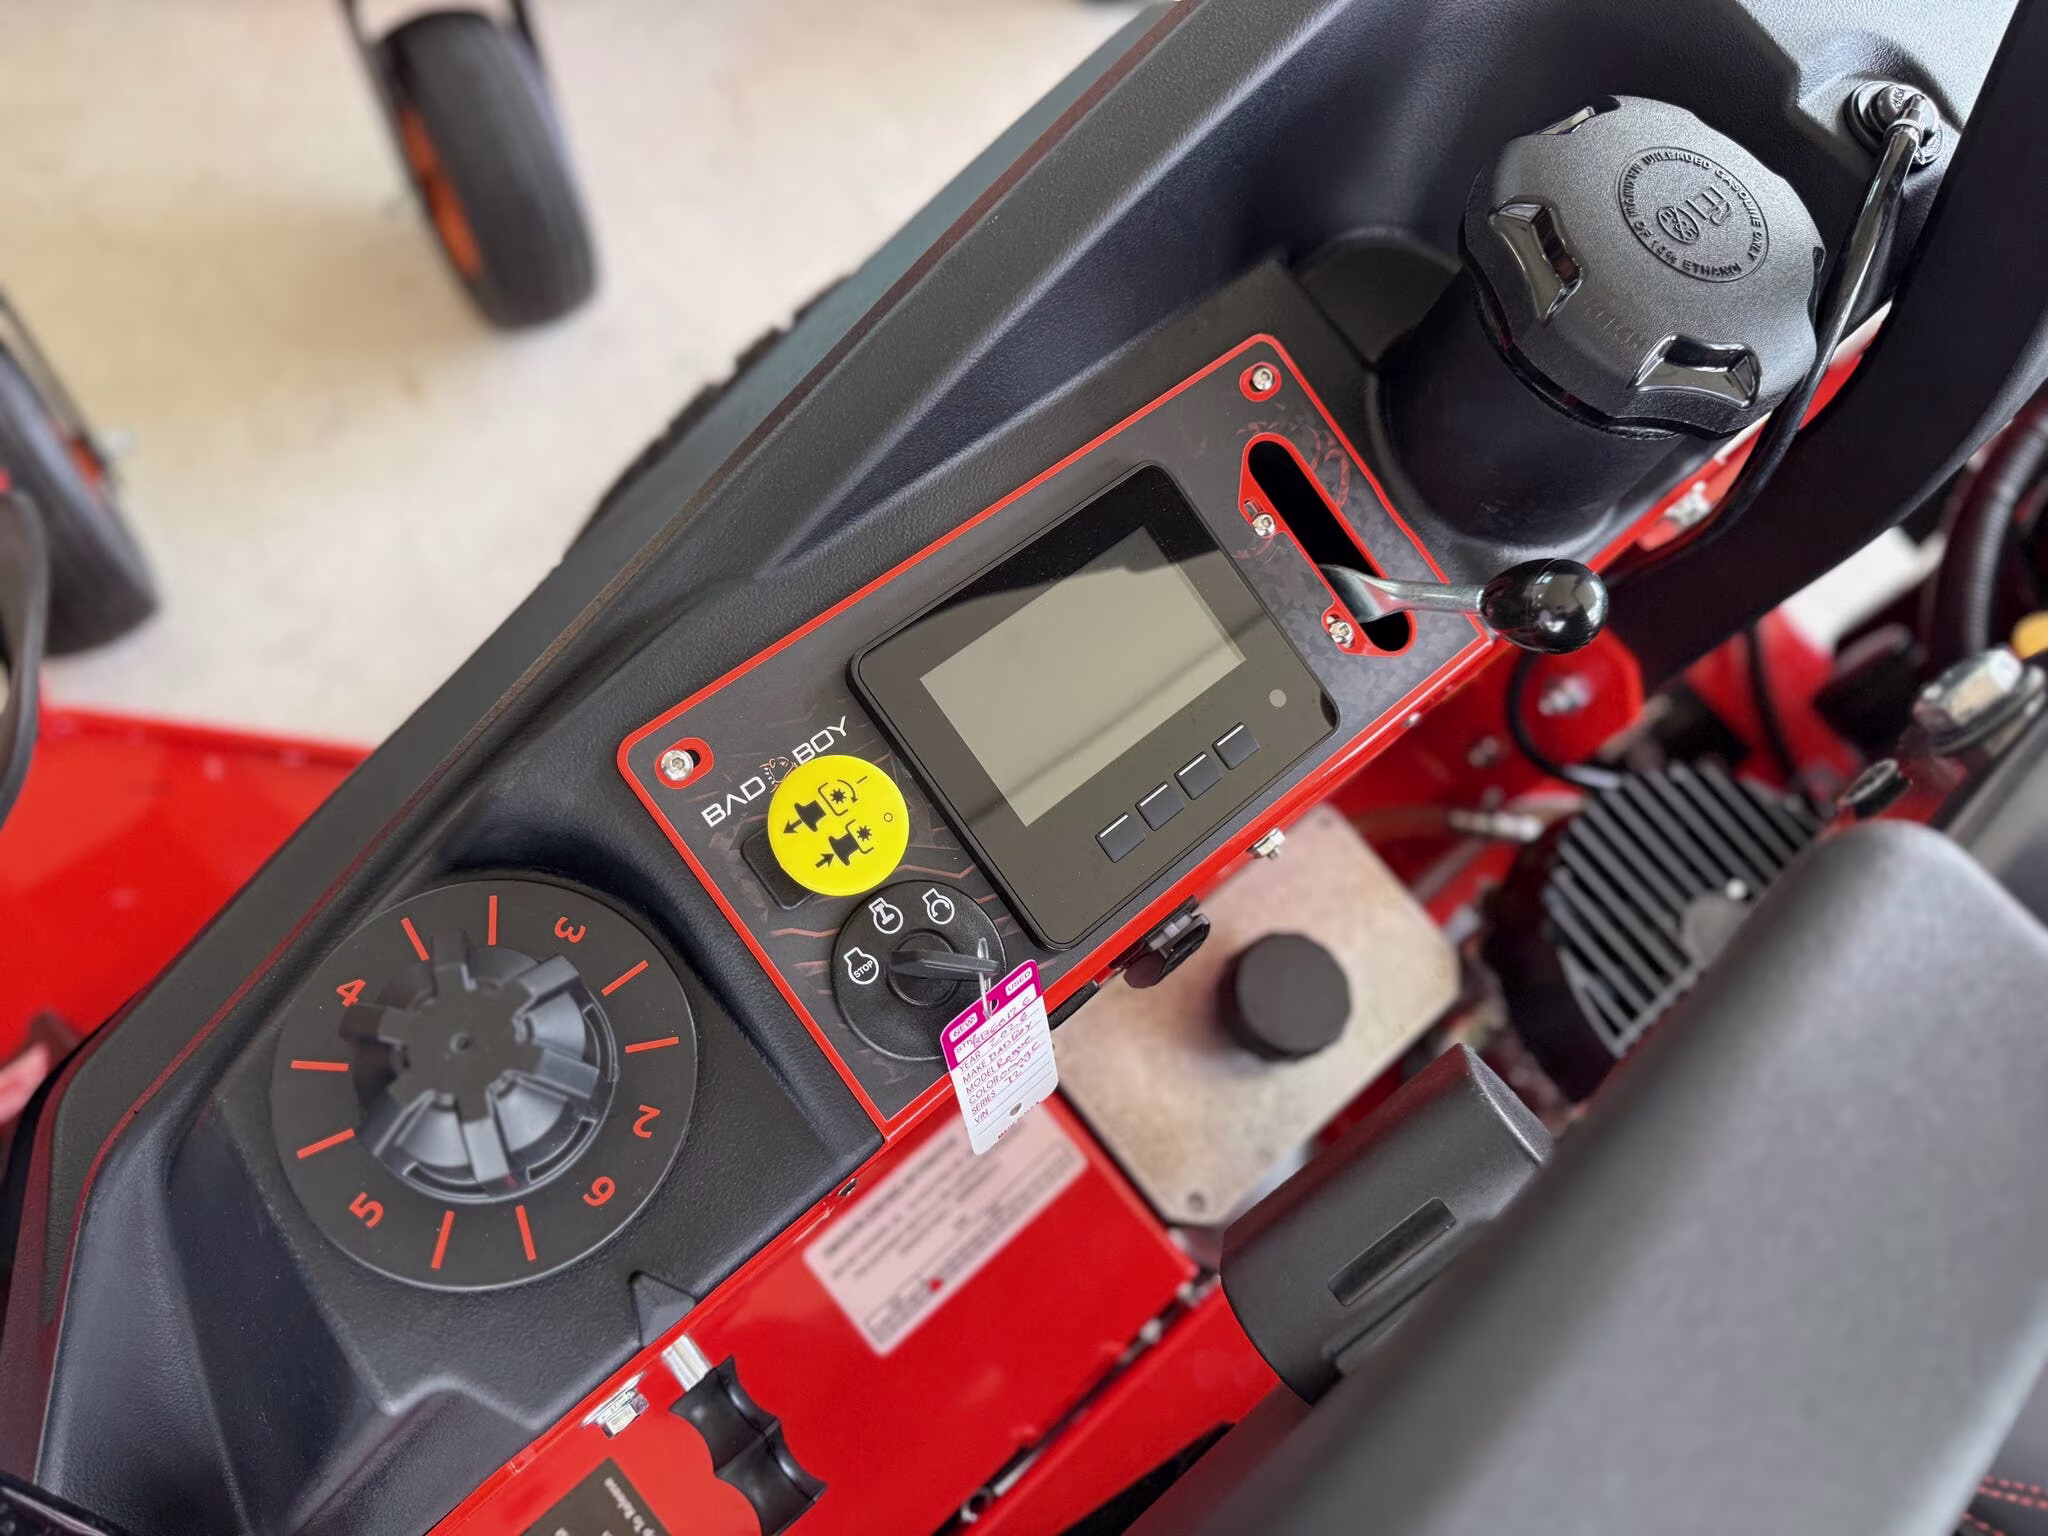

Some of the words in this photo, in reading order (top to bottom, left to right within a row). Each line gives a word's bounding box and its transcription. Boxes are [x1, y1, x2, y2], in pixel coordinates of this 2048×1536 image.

[1642, 151, 1713, 170] UNLEADED
[1714, 169, 1762, 229] GASOLINE
[1747, 231, 1763, 262] ONLY
[701, 775, 766, 828] BAD
[791, 715, 848, 767] BOY
[553, 915, 587, 944] 3
[853, 959, 874, 979] STOP
[1007, 970, 1032, 993] USED
[335, 978, 367, 1008] 4
[953, 1016, 976, 1038] NEW
[959, 1050, 982, 1072] YEAR
[962, 1059, 987, 1083] MAKE
[965, 1065, 995, 1095] MODEL
[968, 1075, 999, 1105] COLOR
[971, 1089, 997, 1115] SERIES
[974, 1108, 989, 1124] VIN
[632, 1104, 661, 1139] 2
[348, 1190, 385, 1229] 5
